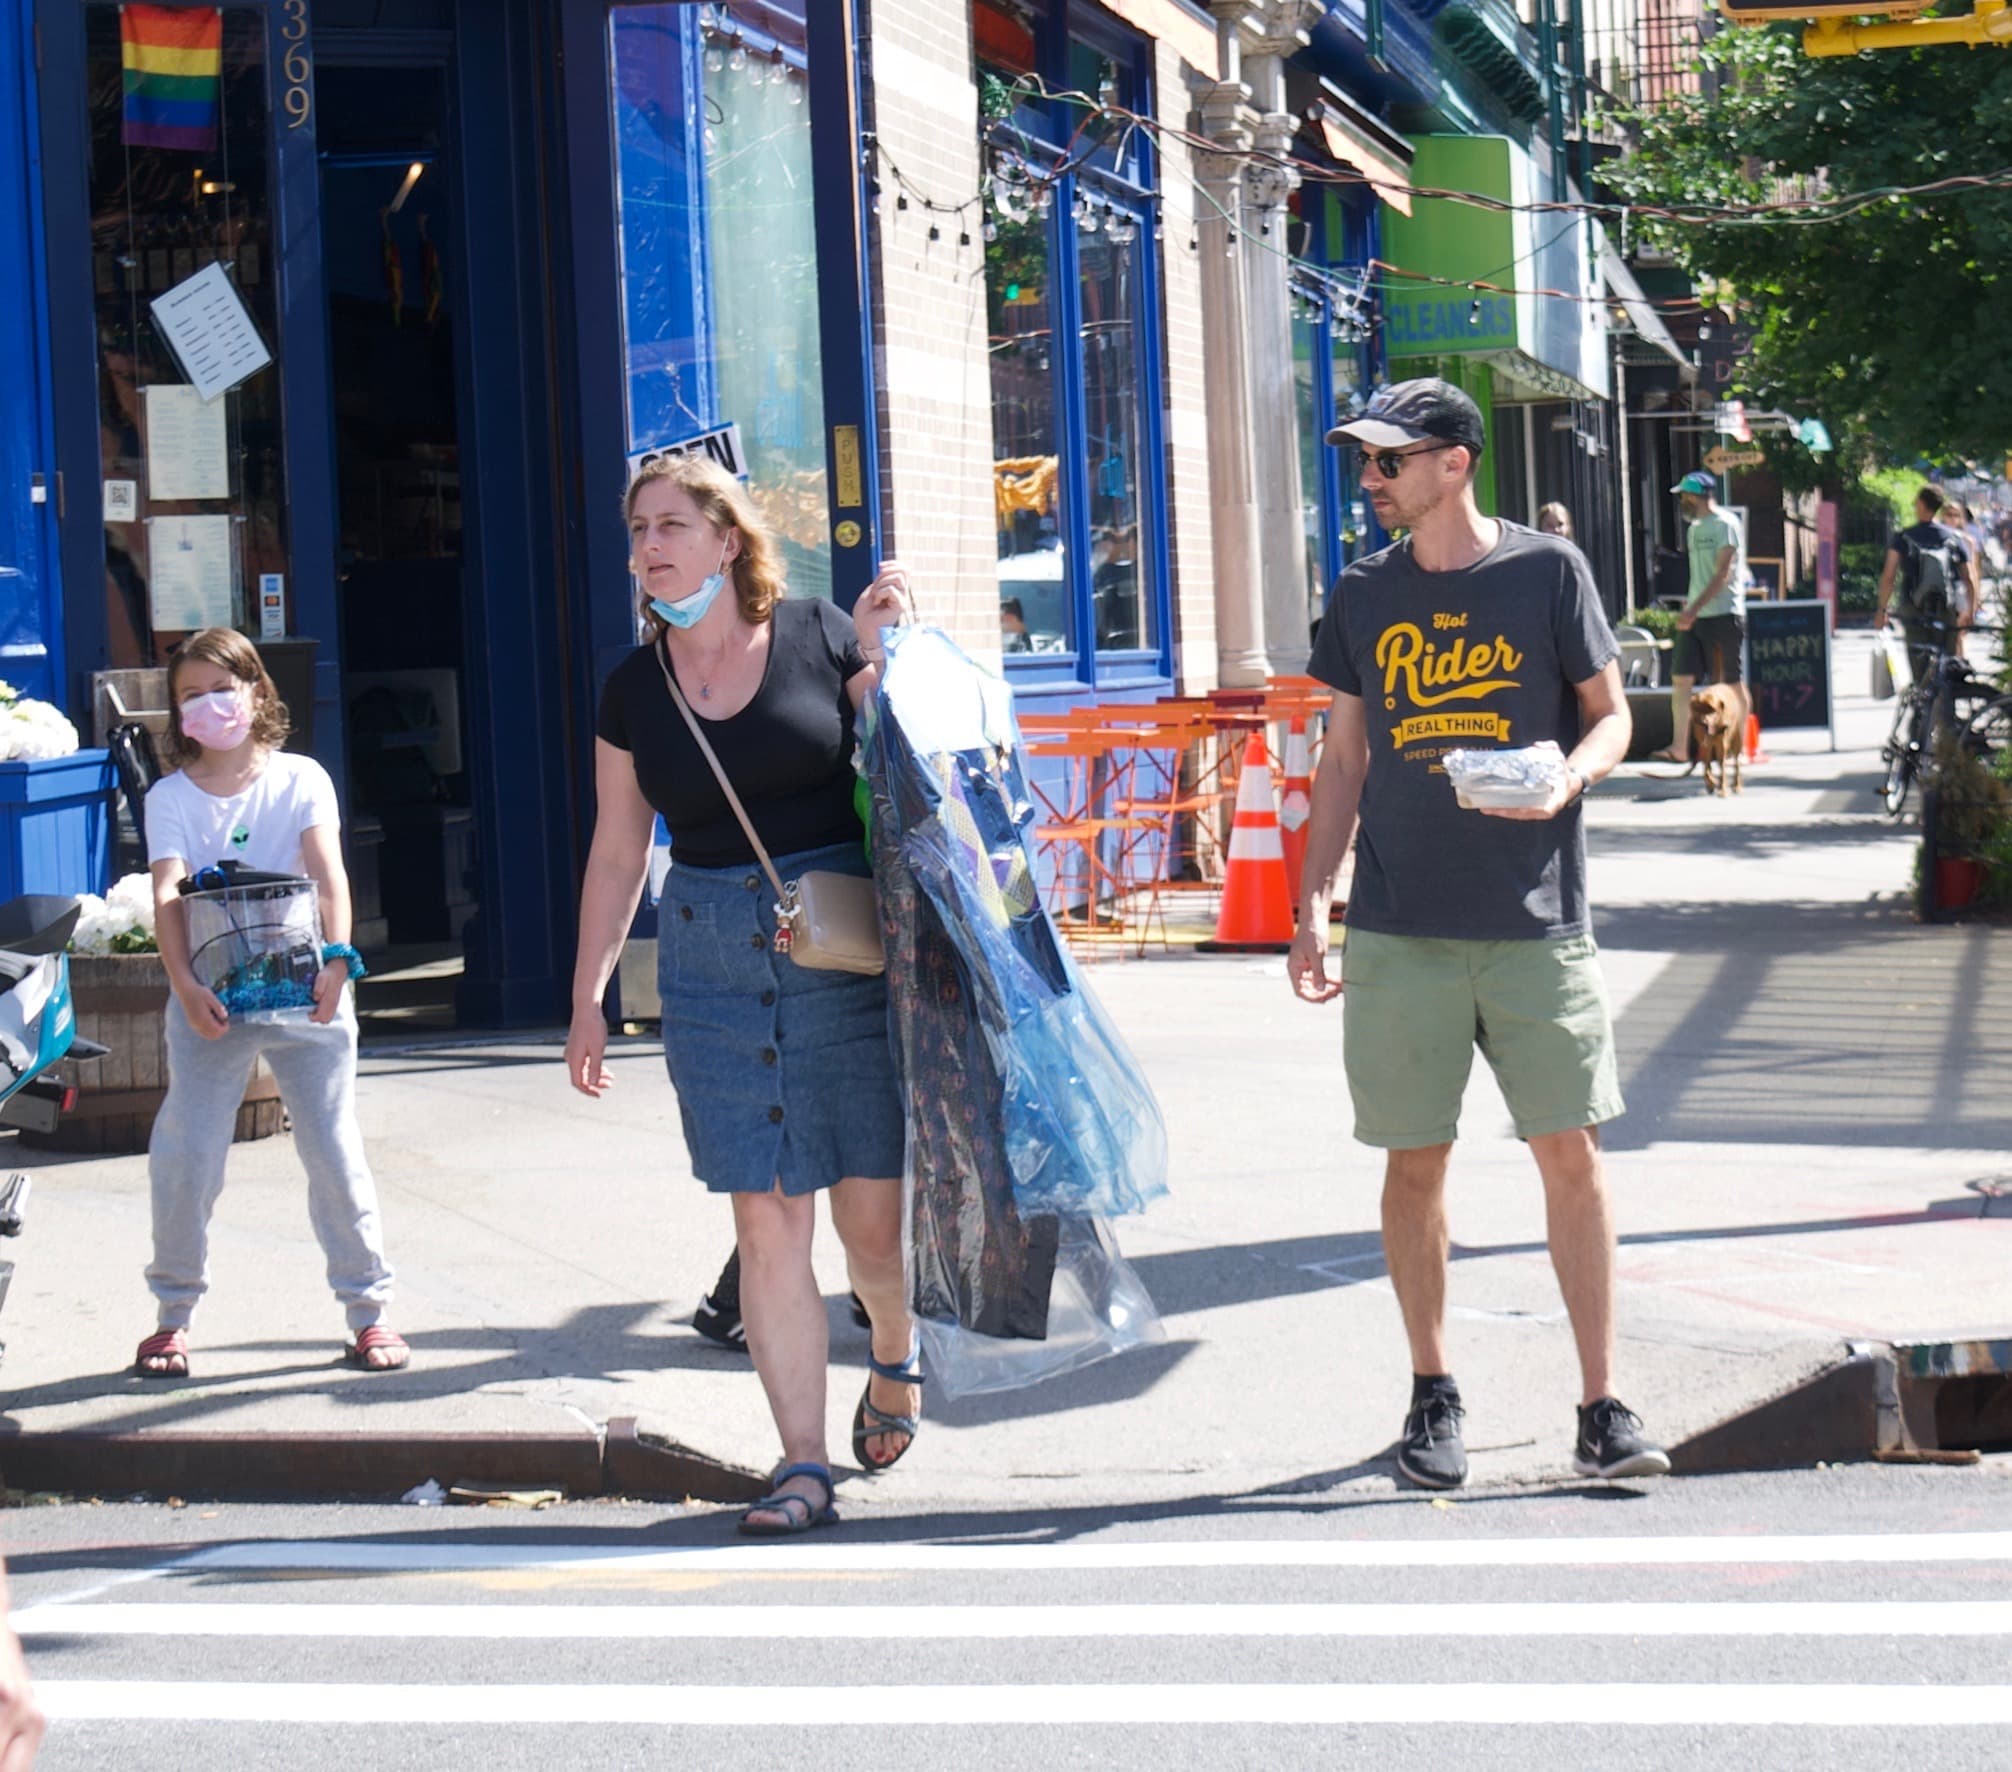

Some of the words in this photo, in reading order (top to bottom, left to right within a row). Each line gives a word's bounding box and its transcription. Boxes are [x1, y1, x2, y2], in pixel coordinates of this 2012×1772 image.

[282, 0, 309, 128] 369
[1390, 296, 1512, 342] CLEANERS
[1433, 612, 1468, 630] Hot
[1376, 622, 1523, 708] Rider
[1752, 634, 1823, 660] HAPPY
[1406, 718, 1443, 737] REAL
[1445, 718, 1495, 733] THING
